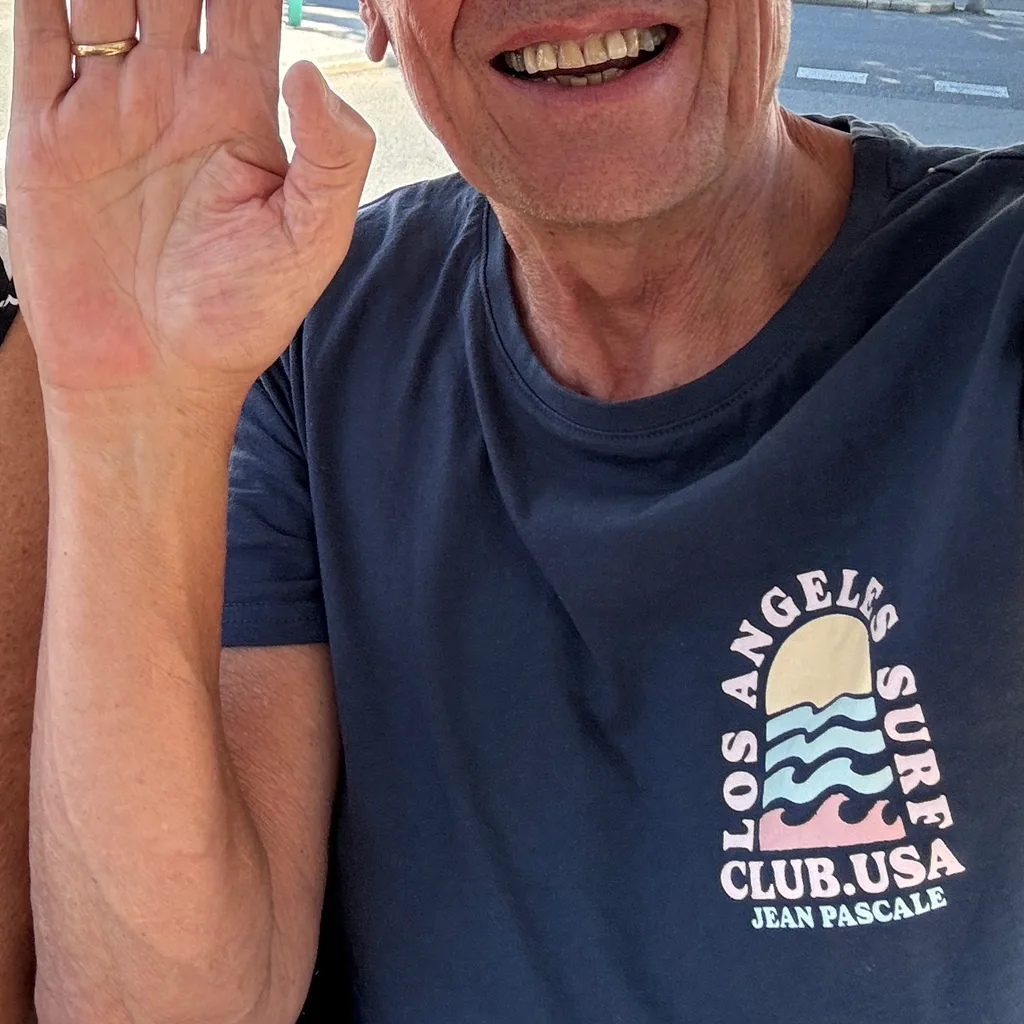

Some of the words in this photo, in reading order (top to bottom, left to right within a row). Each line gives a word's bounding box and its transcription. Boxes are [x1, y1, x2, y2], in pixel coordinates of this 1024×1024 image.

[721, 568, 900, 709] ANGELES
[722, 729, 758, 853] LOS
[876, 663, 954, 829] SURF
[720, 837, 966, 901] CLUB.USA
[750, 904, 815, 930] JEAN
[819, 885, 947, 929] PASCALE
